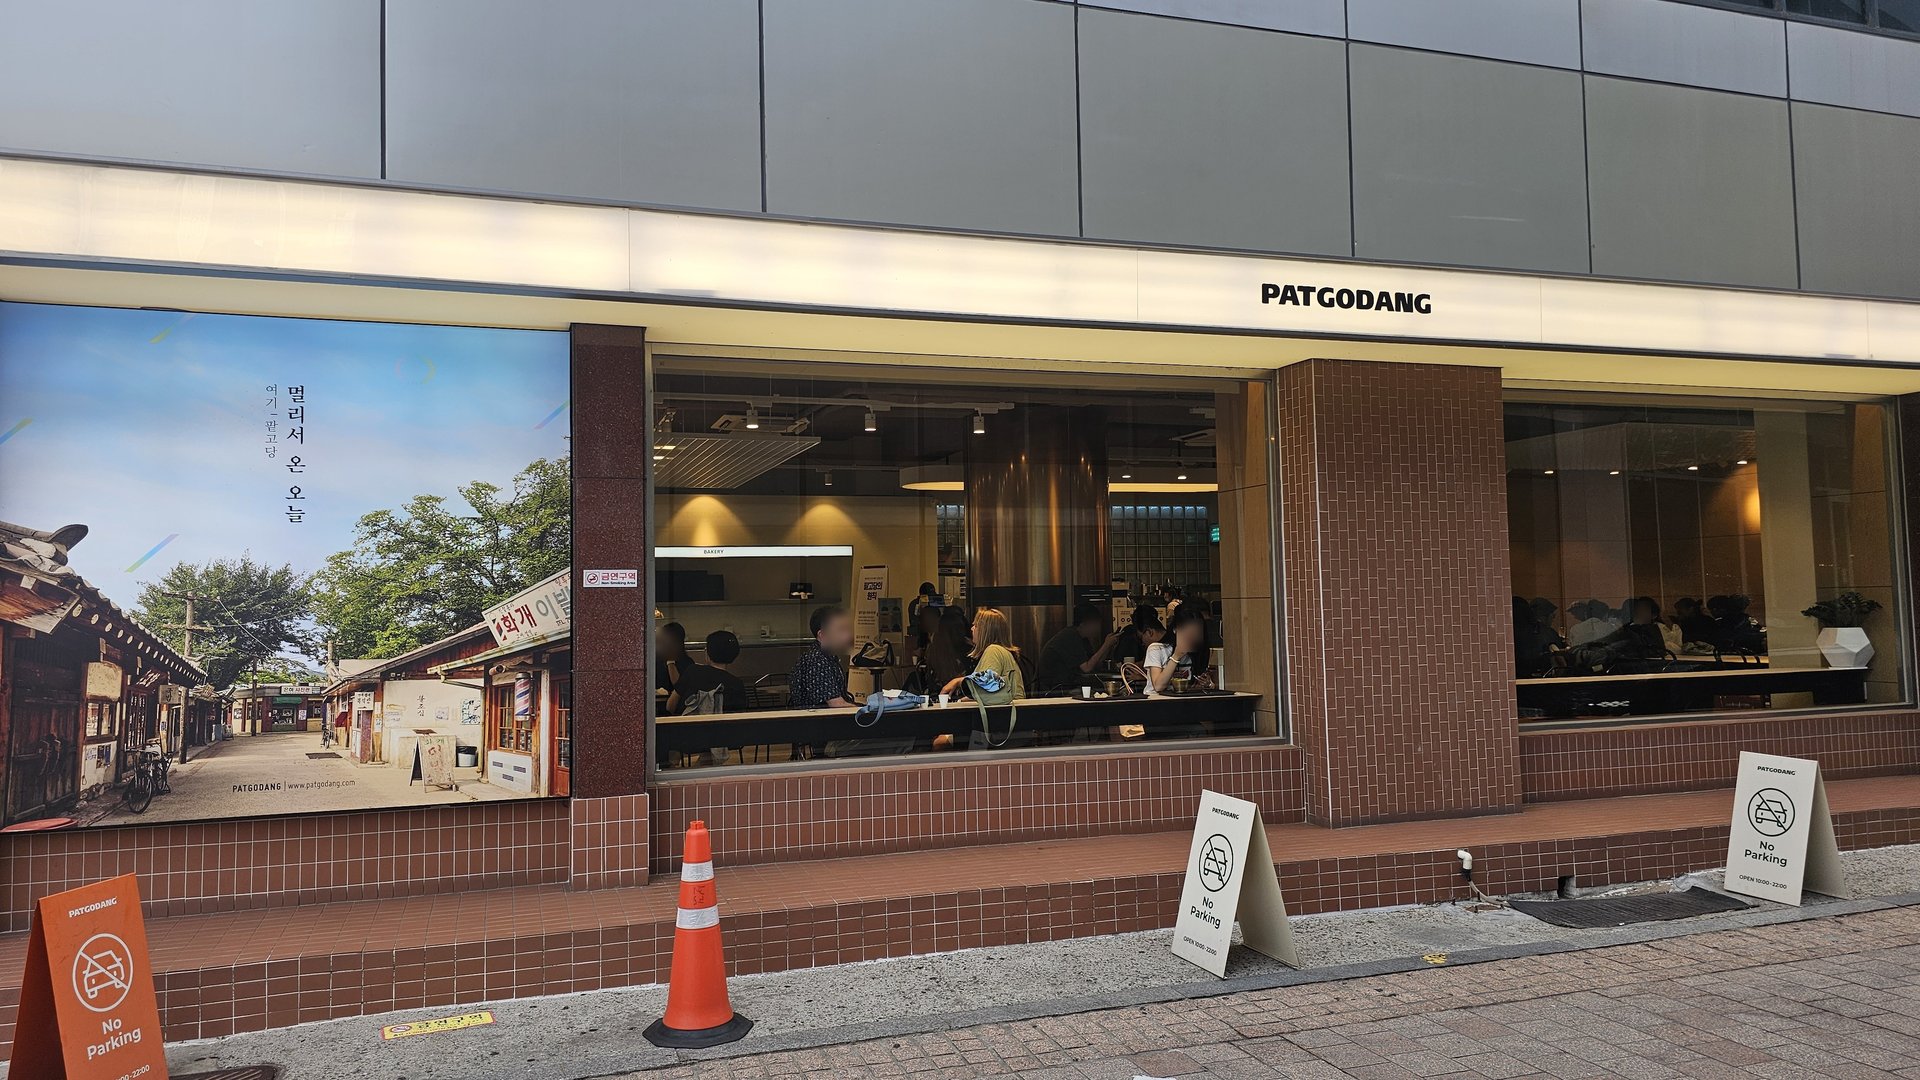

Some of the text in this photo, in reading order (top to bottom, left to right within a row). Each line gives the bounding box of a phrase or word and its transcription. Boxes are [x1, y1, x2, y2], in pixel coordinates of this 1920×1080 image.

[1262, 283, 1432, 314] PATGODANG
[285, 385, 306, 523] 멀리서 온 오늘
[601, 572, 636, 581] 금연구역
[501, 604, 537, 633] 화개
[1757, 765, 1796, 776] PATGODANG
[232, 780, 356, 793] PATGODANG www.patgodang.com
[1212, 807, 1240, 820] PATGODANG
[1759, 841, 1775, 851] No
[1744, 849, 1788, 867] Parking
[1739, 874, 1755, 882] OPEN
[68, 897, 118, 918] PATGODANG
[1202, 896, 1214, 909] No
[1190, 906, 1221, 930] Parking
[1183, 936, 1195, 945] OPEN
[102, 1018, 122, 1034] No
[87, 1027, 142, 1060] Parking
